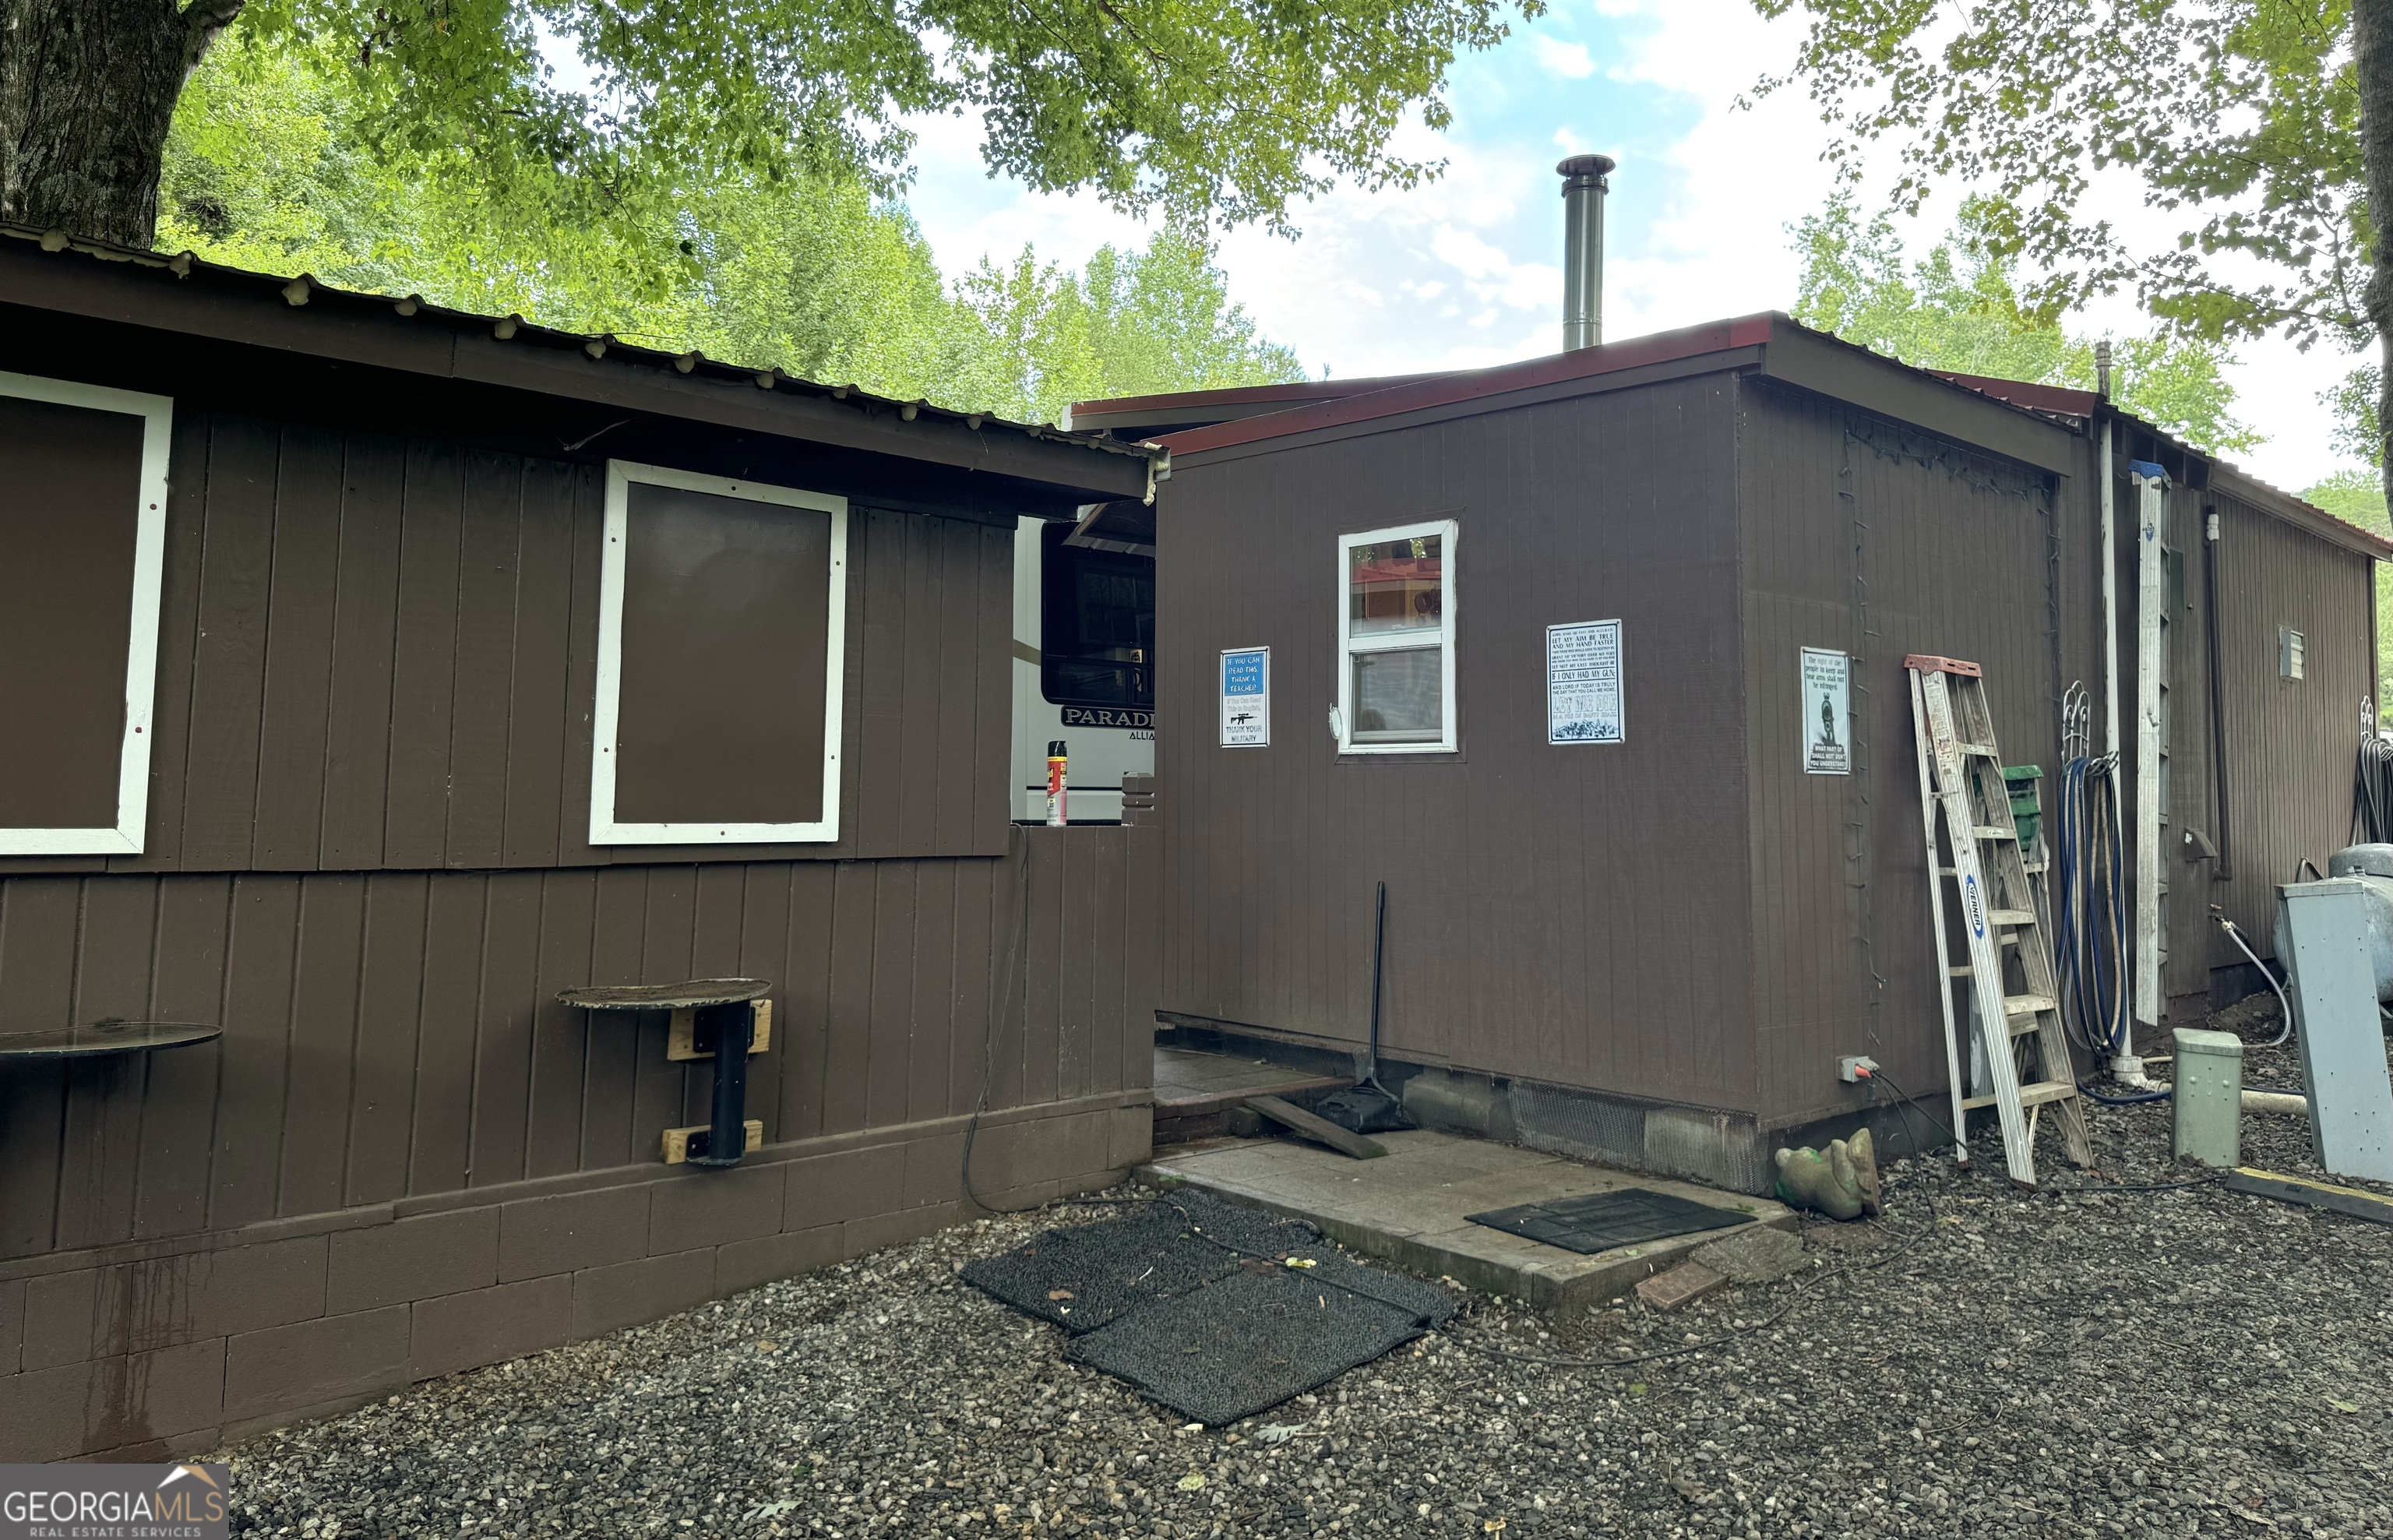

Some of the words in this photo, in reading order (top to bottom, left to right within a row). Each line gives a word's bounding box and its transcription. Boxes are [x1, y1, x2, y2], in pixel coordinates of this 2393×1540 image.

[1553, 696, 1572, 714] LET
[1575, 695, 1593, 712] ME
[1596, 694, 1617, 711] DIE
[1066, 709, 1154, 727] PARADI
[1130, 731, 1154, 740] ALLIA
